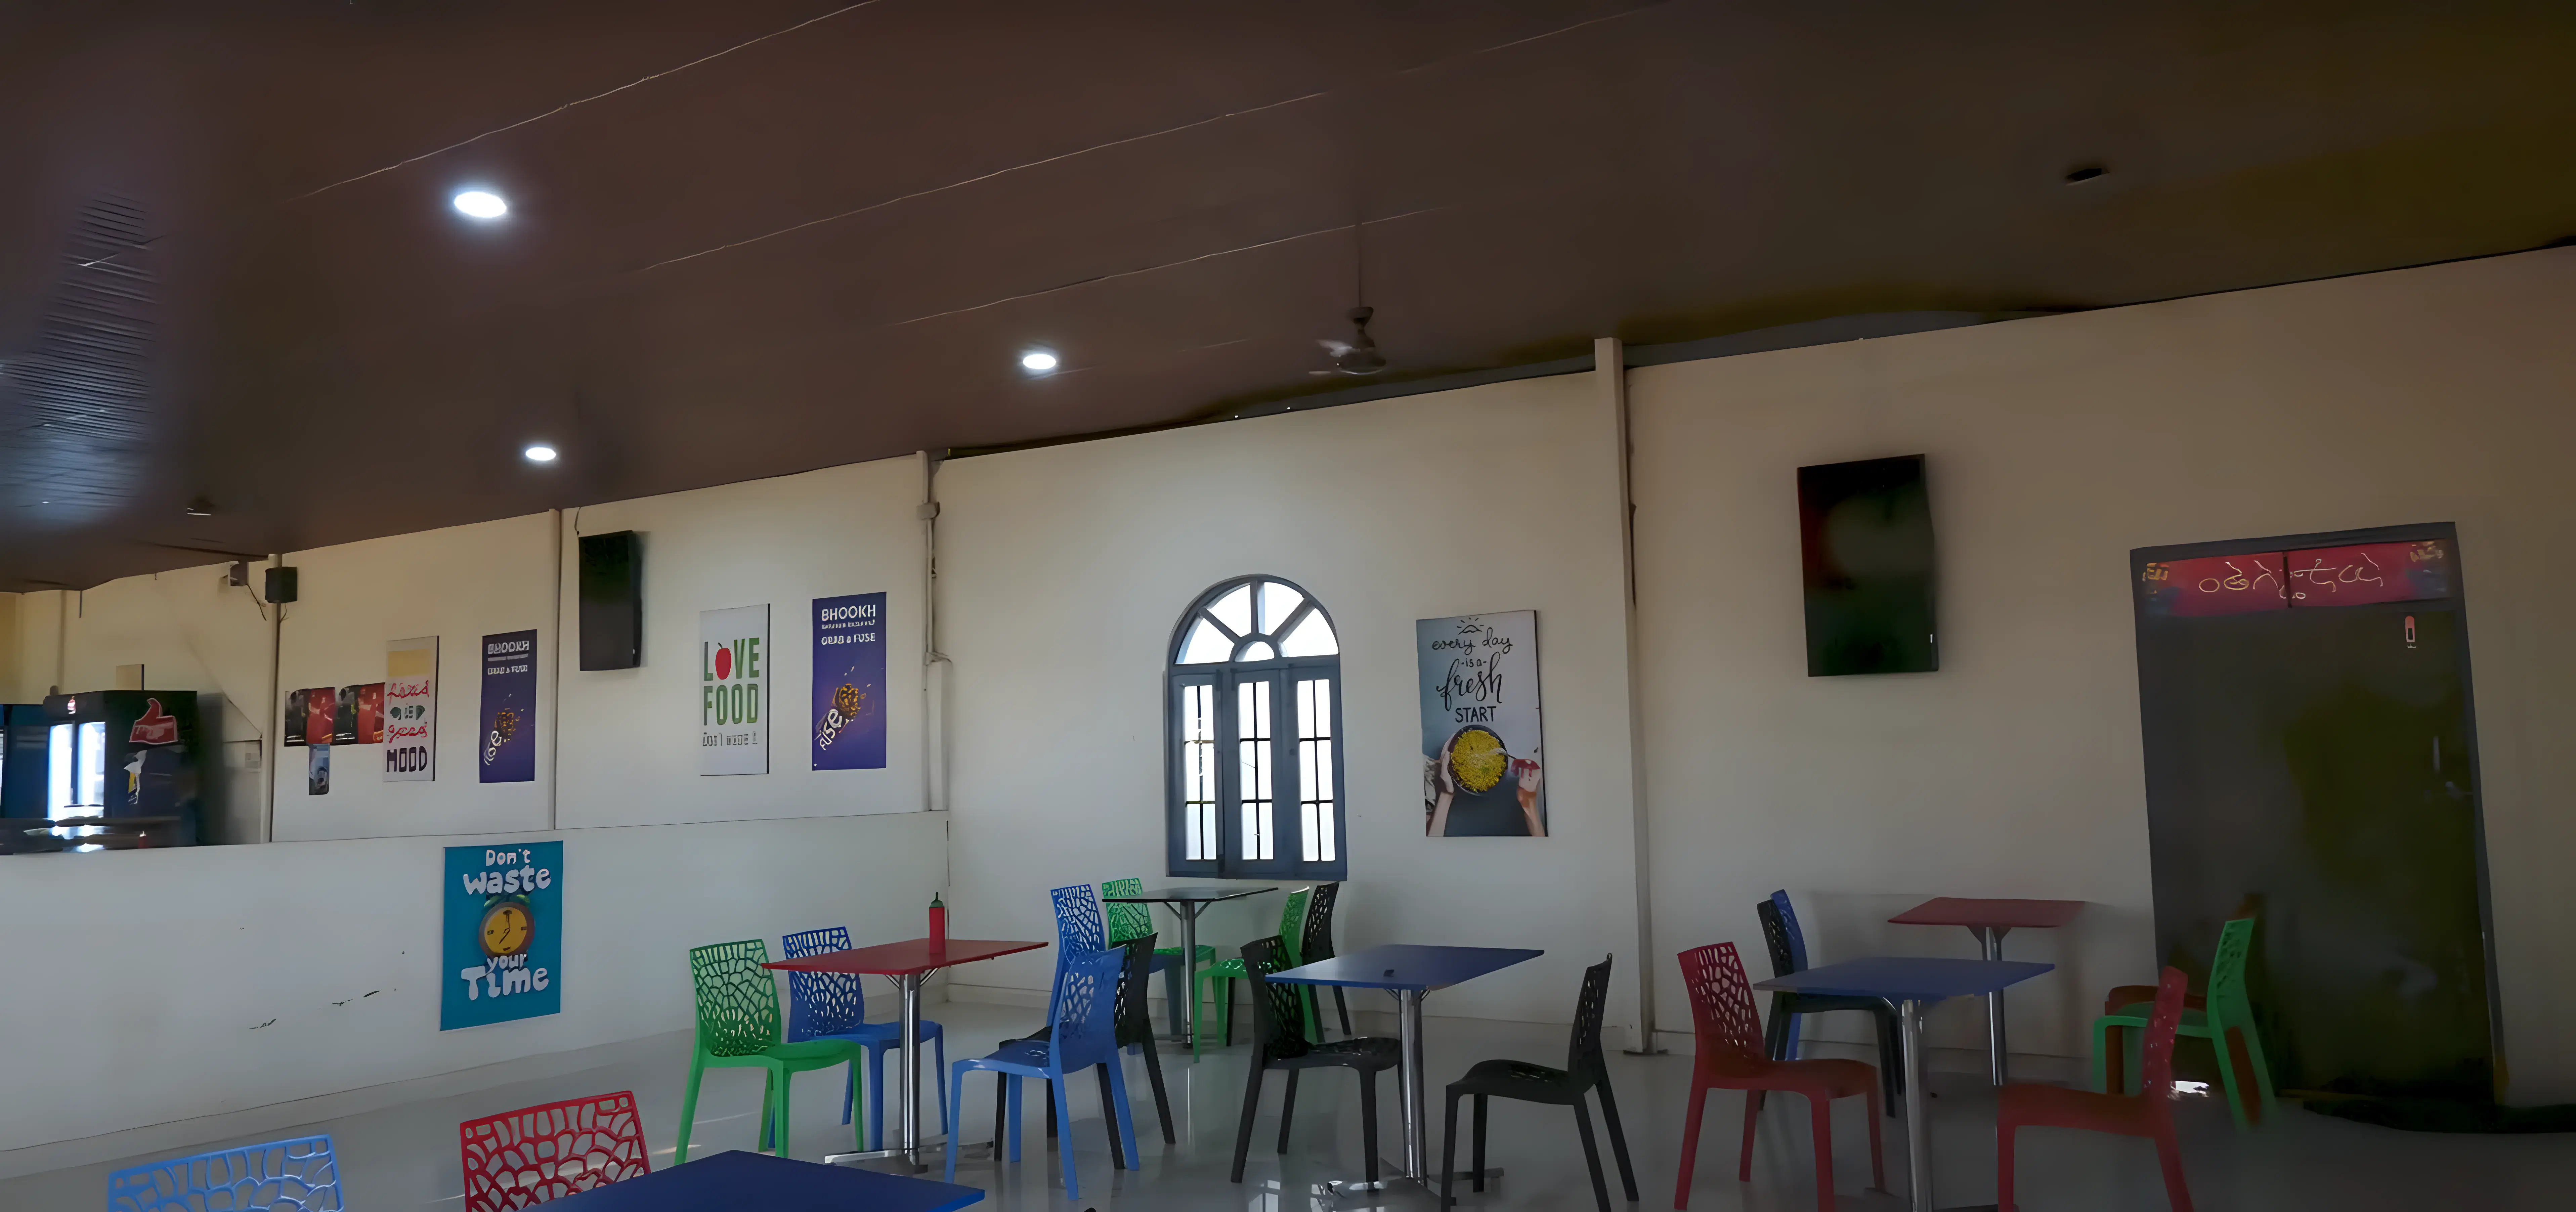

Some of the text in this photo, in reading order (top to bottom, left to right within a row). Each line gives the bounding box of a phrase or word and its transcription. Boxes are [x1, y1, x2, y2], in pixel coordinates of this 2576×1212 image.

[821, 604, 876, 621] BHOOKH
[1432, 627, 1513, 655] every day
[1436, 652, 1502, 711] fresh
[703, 683, 758, 726] FOOD
[1455, 706, 1497, 723] START
[386, 746, 427, 772] MOOD
[486, 849, 531, 866] Don't
[463, 865, 551, 895] waste
[486, 954, 527, 975] your
